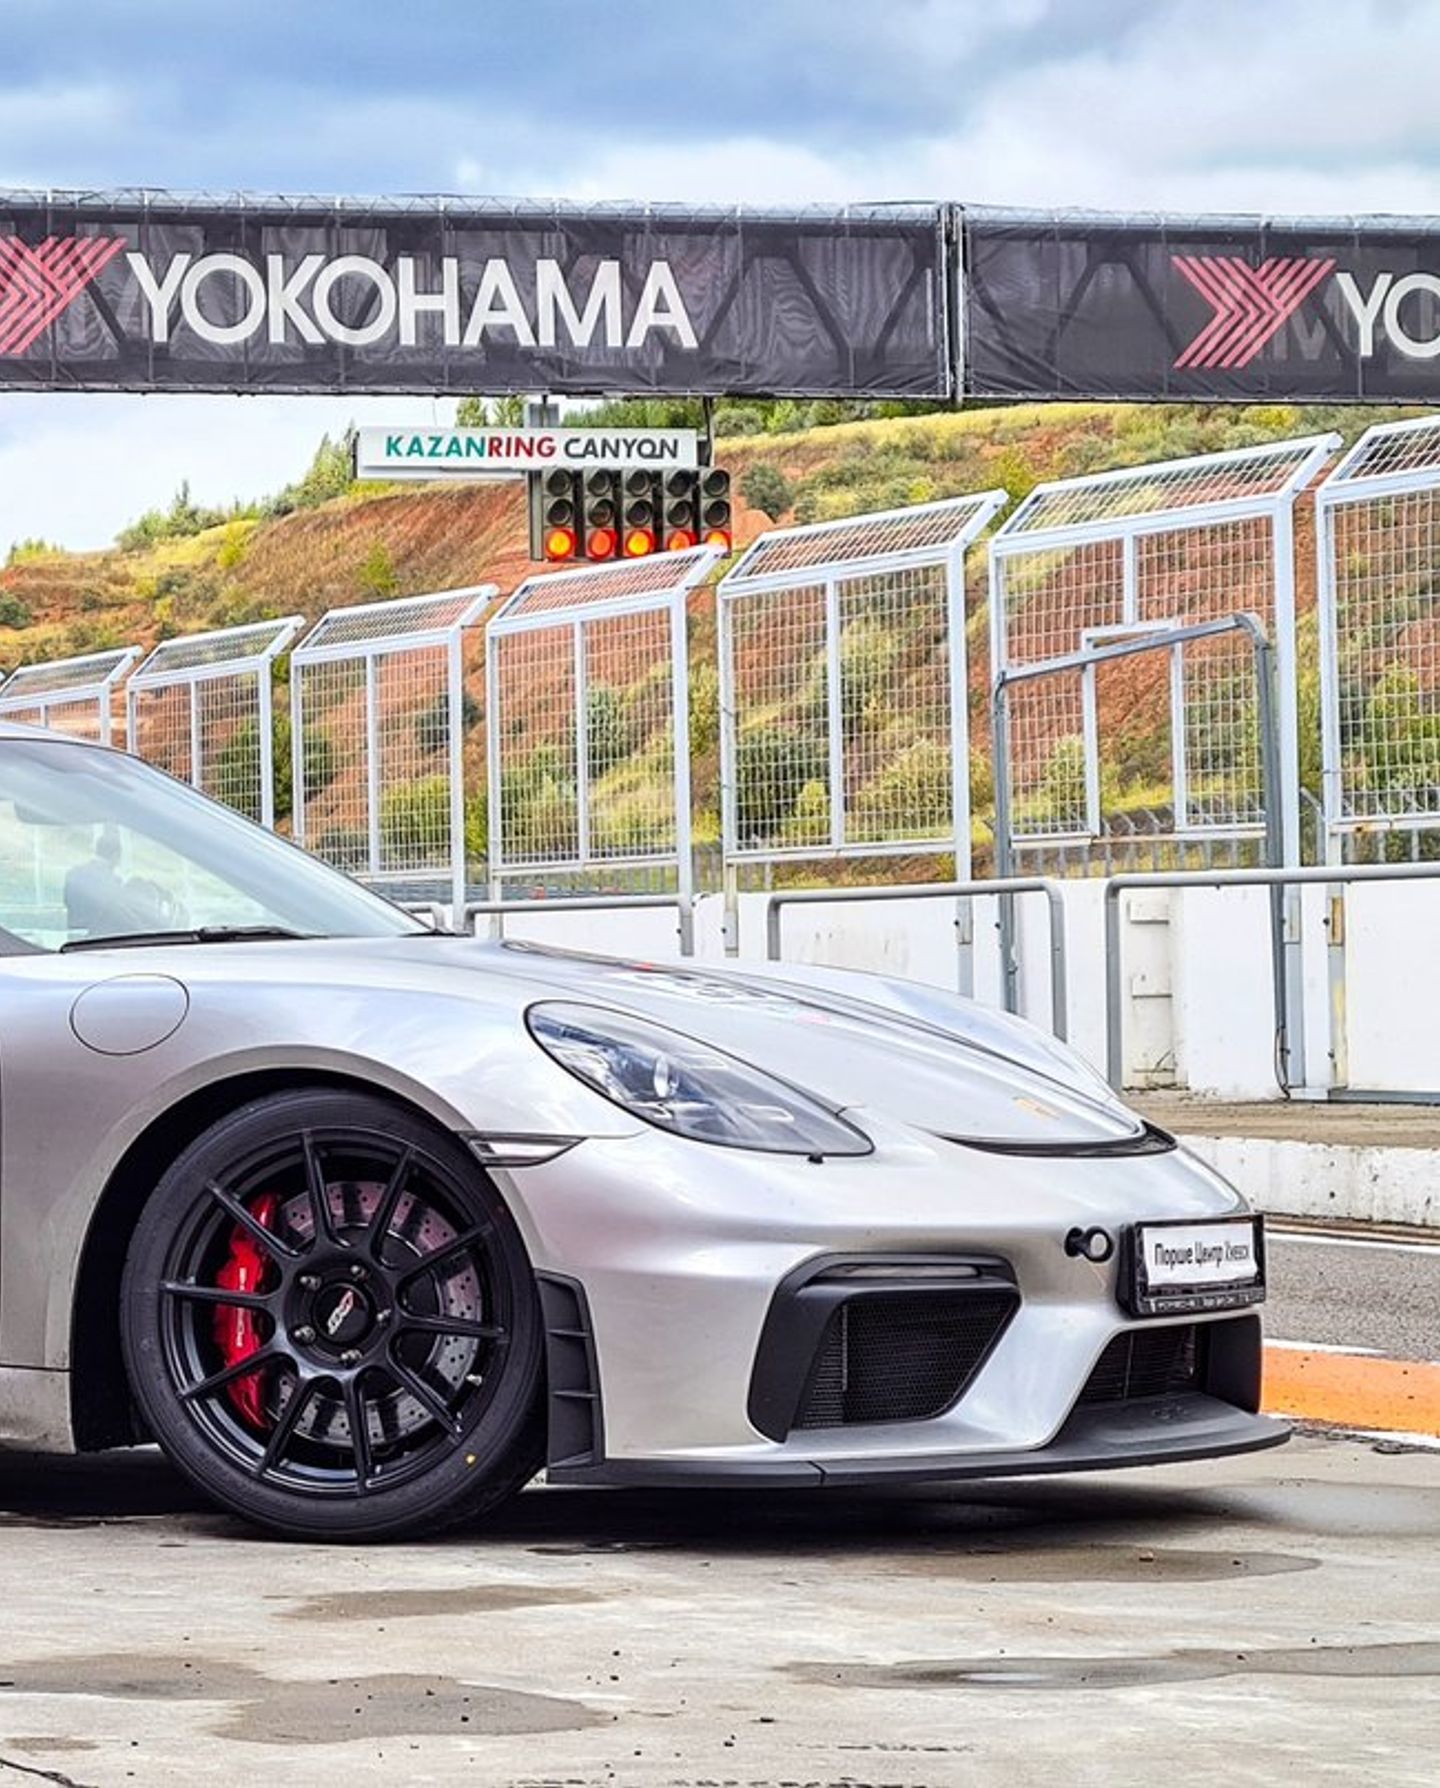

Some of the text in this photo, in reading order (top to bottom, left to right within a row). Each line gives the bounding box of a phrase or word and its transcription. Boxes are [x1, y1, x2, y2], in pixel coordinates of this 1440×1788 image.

[126, 252, 699, 348] YOKOHAMA
[385, 436, 556, 458] KAZANRING
[1154, 1243, 1193, 1270] Порше
